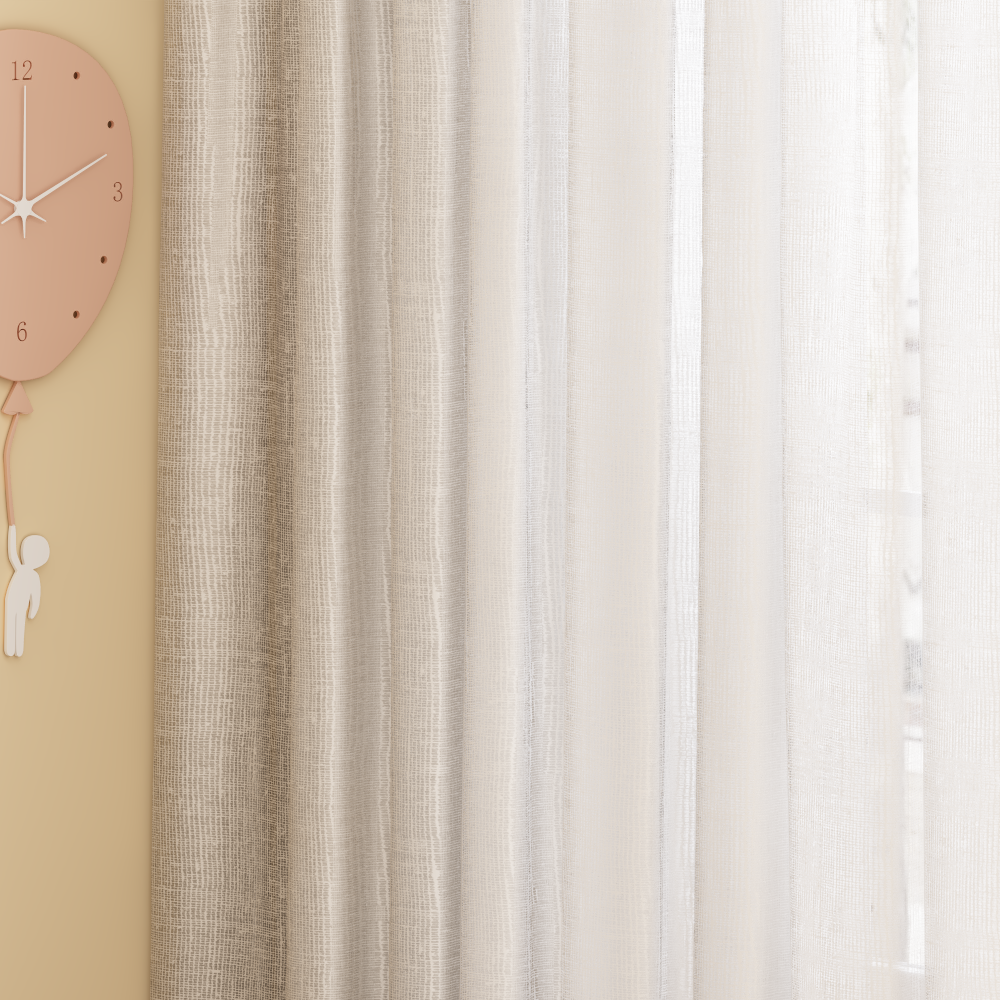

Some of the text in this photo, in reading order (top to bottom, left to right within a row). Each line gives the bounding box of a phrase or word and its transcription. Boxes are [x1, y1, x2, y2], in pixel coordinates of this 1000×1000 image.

[11, 59, 33, 81] 12
[112, 181, 124, 202] 3
[16, 321, 28, 342] 6
